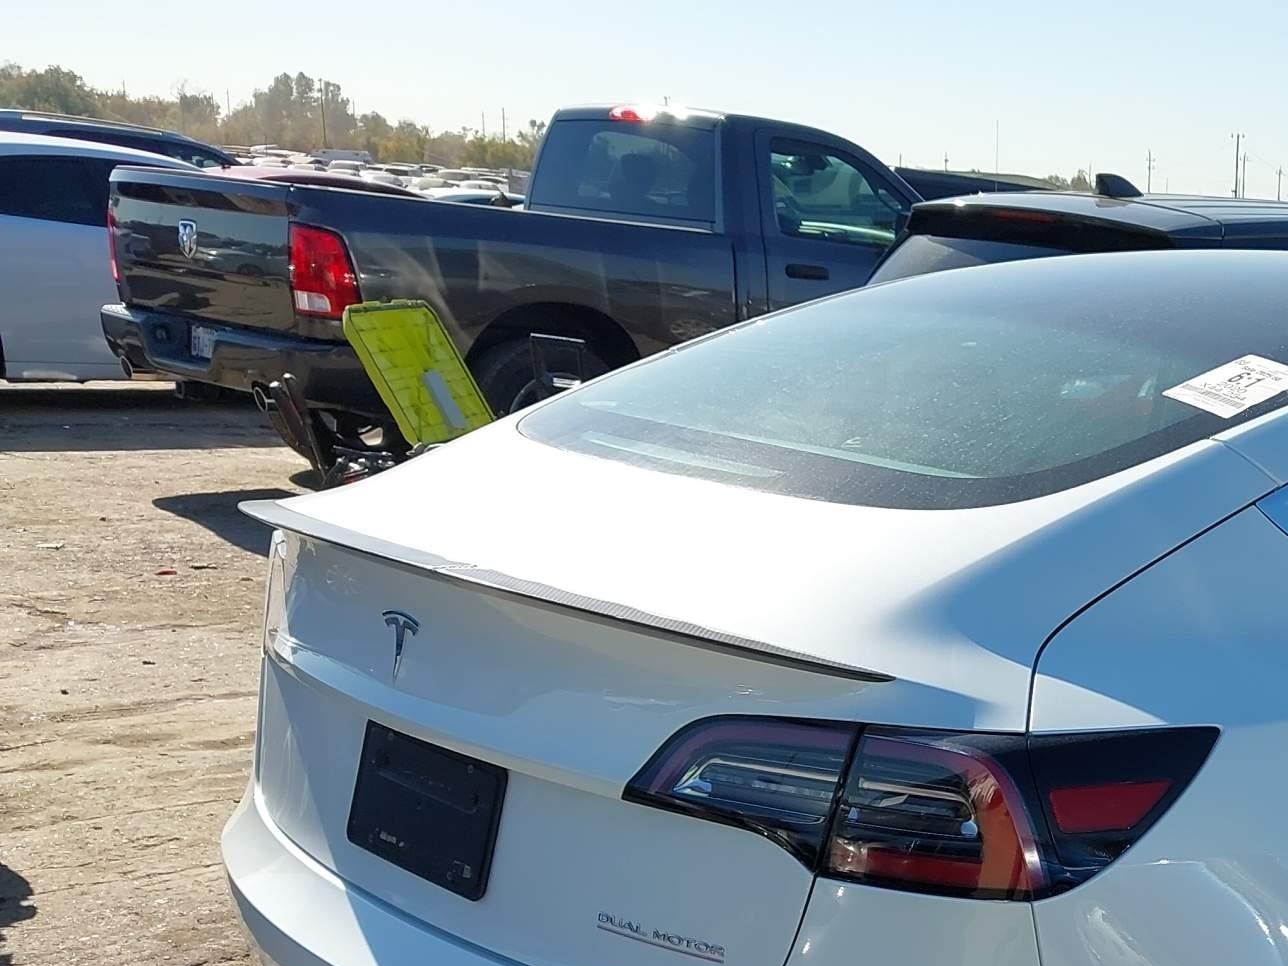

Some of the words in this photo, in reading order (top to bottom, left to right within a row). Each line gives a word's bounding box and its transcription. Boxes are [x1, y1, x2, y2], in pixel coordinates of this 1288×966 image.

[1228, 371, 1266, 388] 6:1
[598, 912, 648, 937] DUAL
[652, 929, 725, 957] MOTOR
